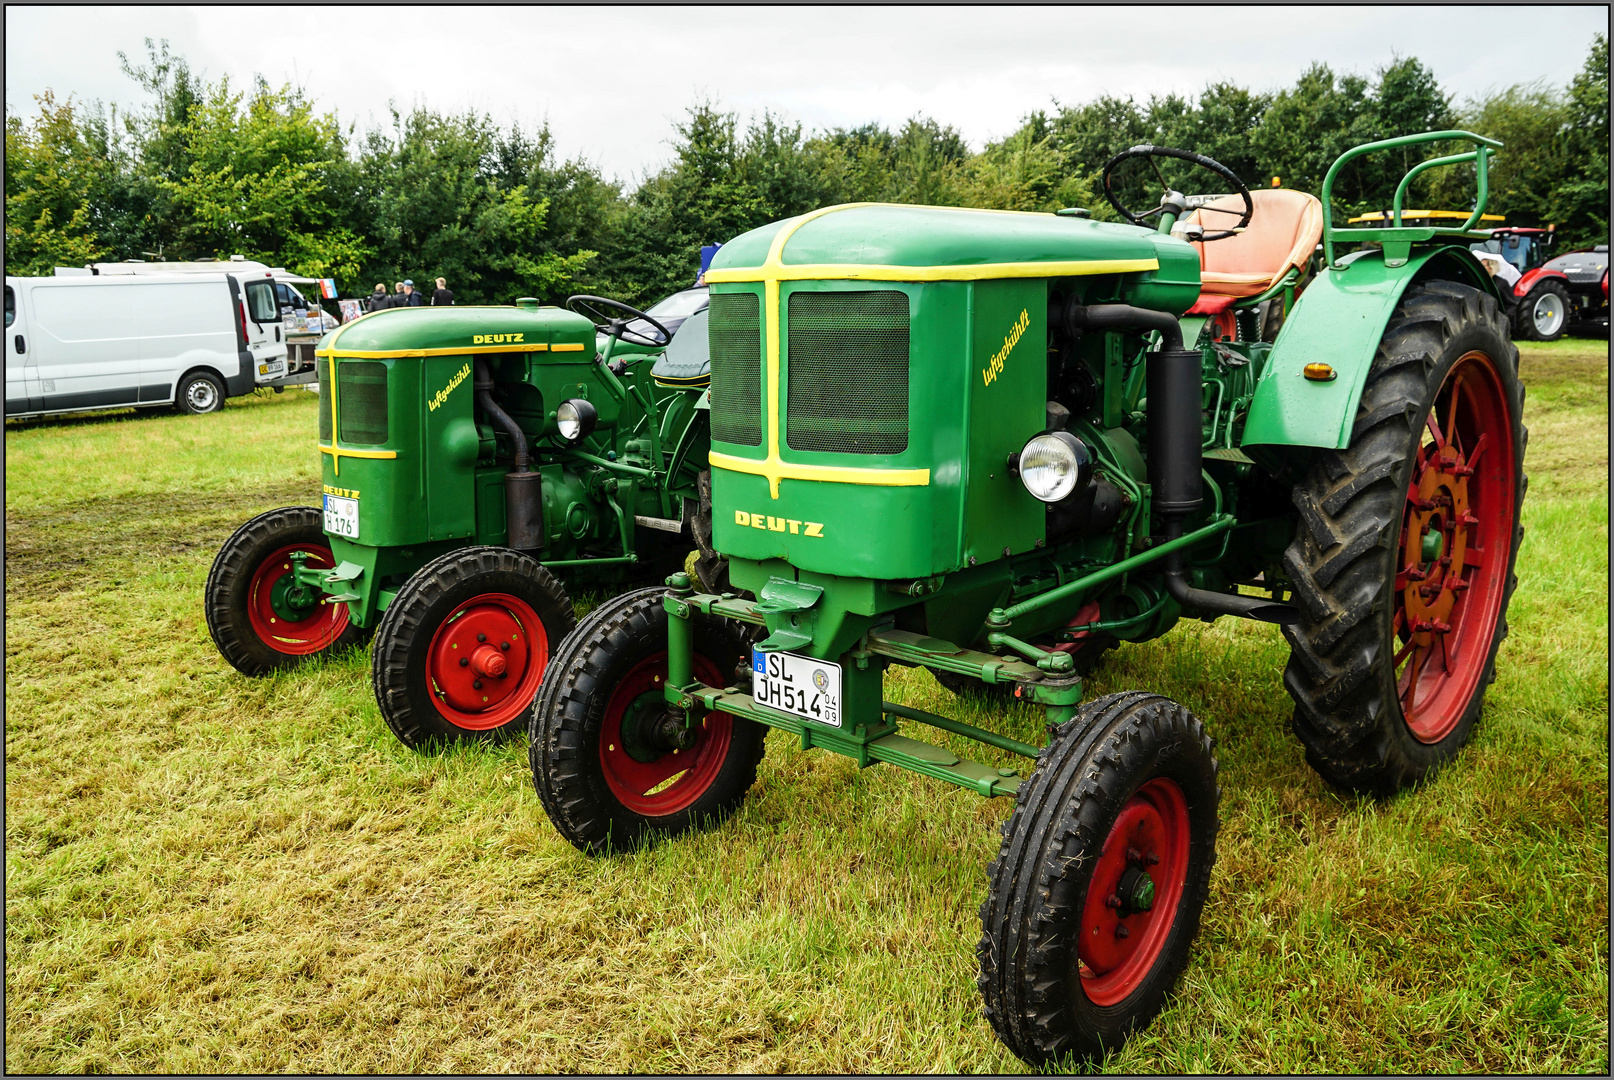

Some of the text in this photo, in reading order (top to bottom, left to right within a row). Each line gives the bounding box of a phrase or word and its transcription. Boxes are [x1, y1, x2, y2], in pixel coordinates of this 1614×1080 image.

[473, 333, 525, 344] DEUTZ
[982, 308, 1030, 387] luftgekühlt
[428, 362, 471, 412] luftgekühlt
[323, 484, 360, 499] DEUTZ
[328, 498, 338, 514] SL
[335, 517, 352, 534] 176
[735, 509, 824, 538] DEUTZ
[757, 663, 763, 671] D
[769, 654, 793, 682] SL
[758, 678, 821, 717] JH514
[825, 693, 836, 706] 04
[825, 710, 836, 722] 09
